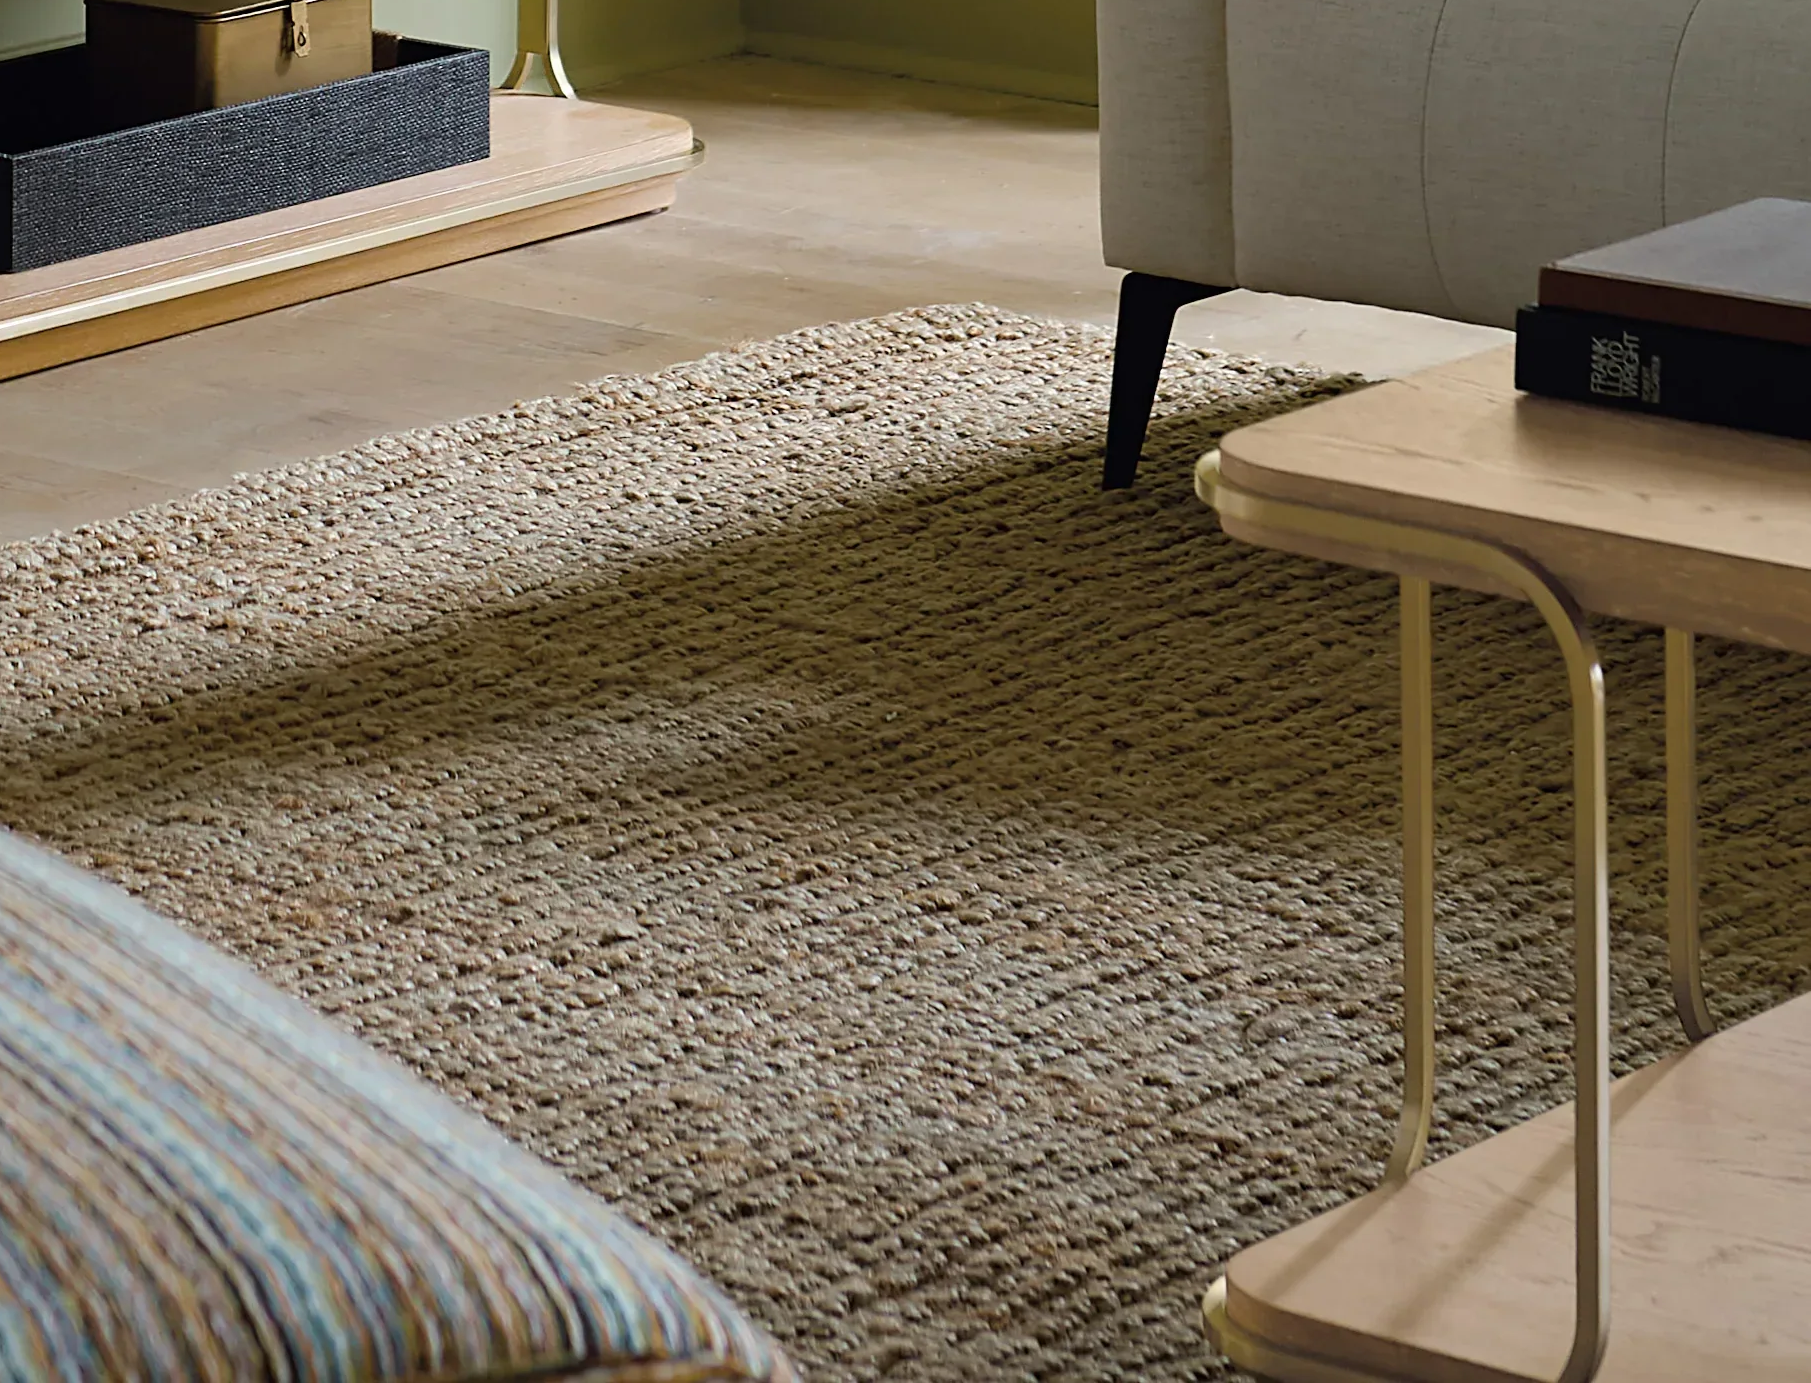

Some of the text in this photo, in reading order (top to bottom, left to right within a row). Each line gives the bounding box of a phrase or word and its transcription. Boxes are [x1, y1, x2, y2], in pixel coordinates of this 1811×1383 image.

[1591, 336, 1608, 393] FRANK
[1607, 340, 1623, 396] LLOYD
[1622, 330, 1640, 397] WRIGHT
